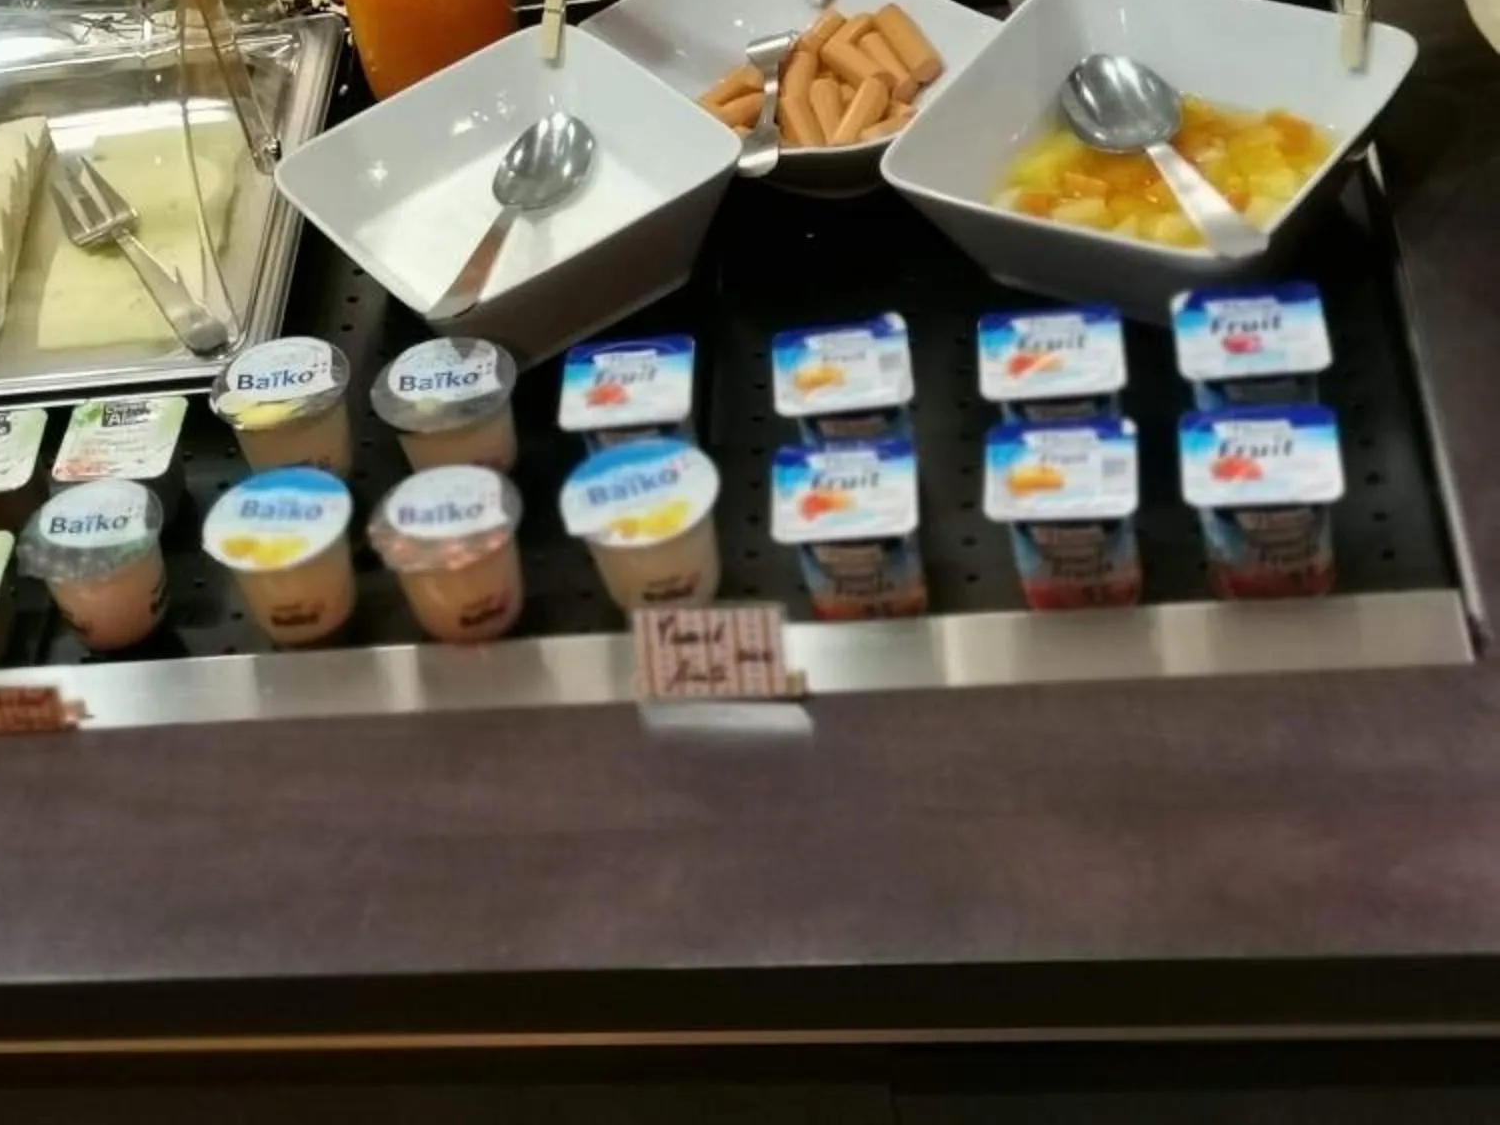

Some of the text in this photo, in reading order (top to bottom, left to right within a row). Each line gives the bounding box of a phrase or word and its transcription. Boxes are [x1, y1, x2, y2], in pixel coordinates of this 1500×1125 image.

[237, 369, 314, 391] Baïko
[400, 369, 479, 392] Baïko
[49, 513, 130, 534] Baïko
